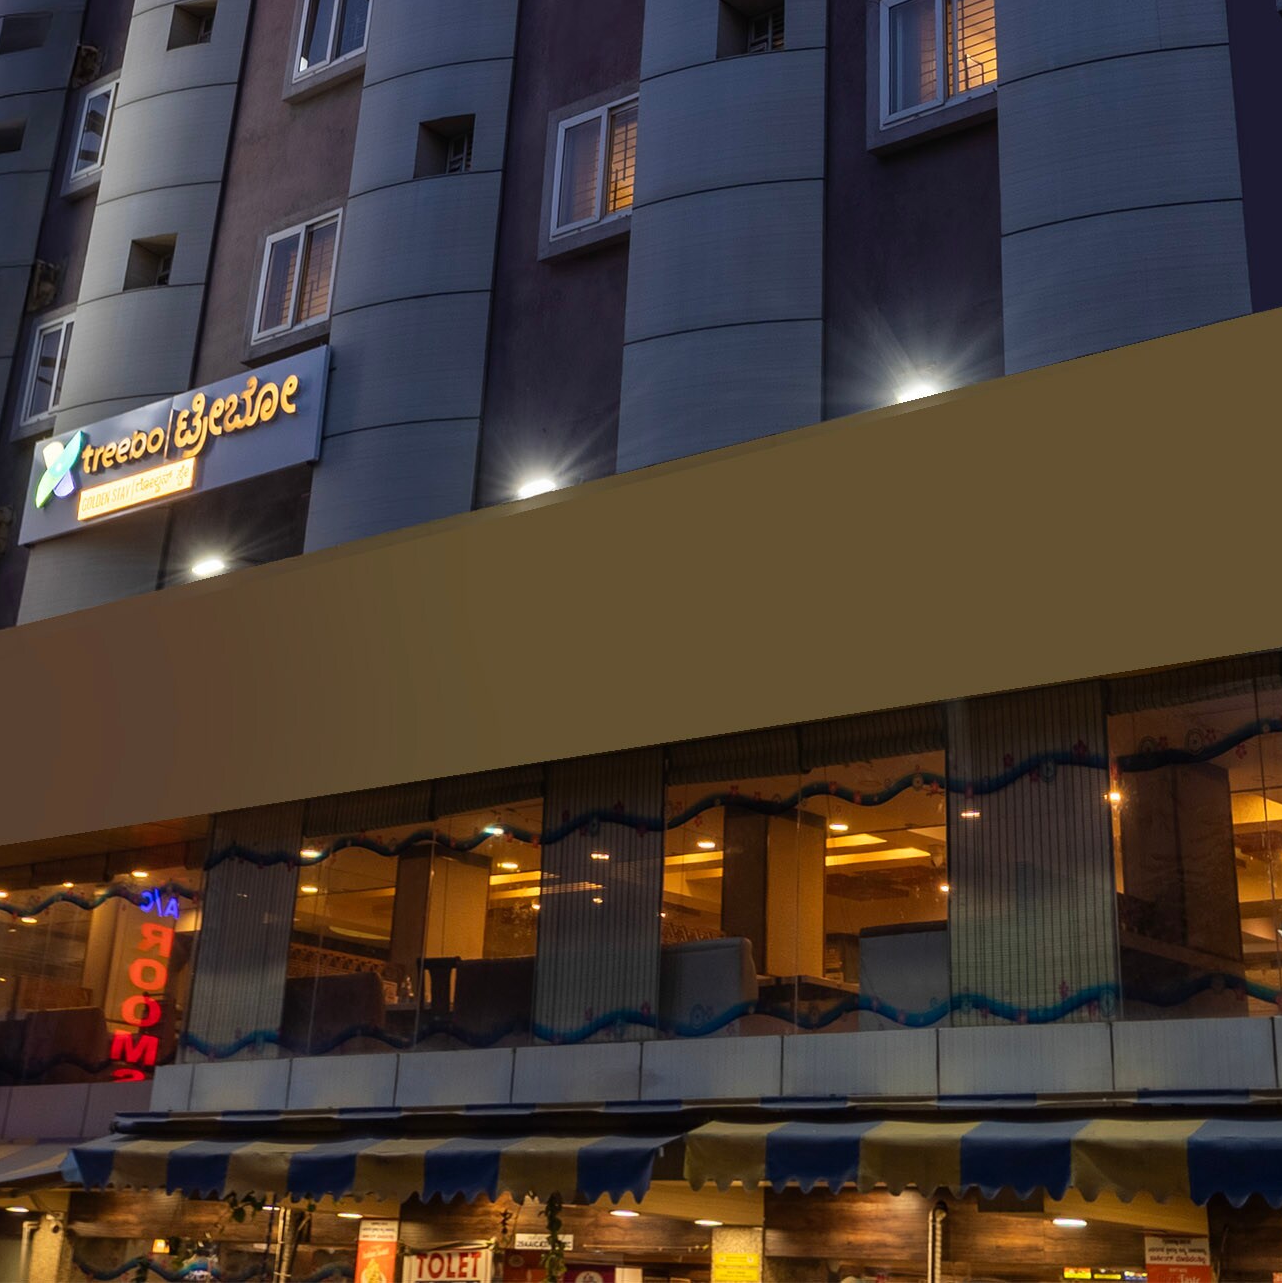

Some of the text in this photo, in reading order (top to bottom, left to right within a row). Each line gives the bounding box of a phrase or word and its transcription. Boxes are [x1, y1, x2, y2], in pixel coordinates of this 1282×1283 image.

[82, 426, 164, 474] treebo
[81, 482, 132, 512] GOLDEN STAY
